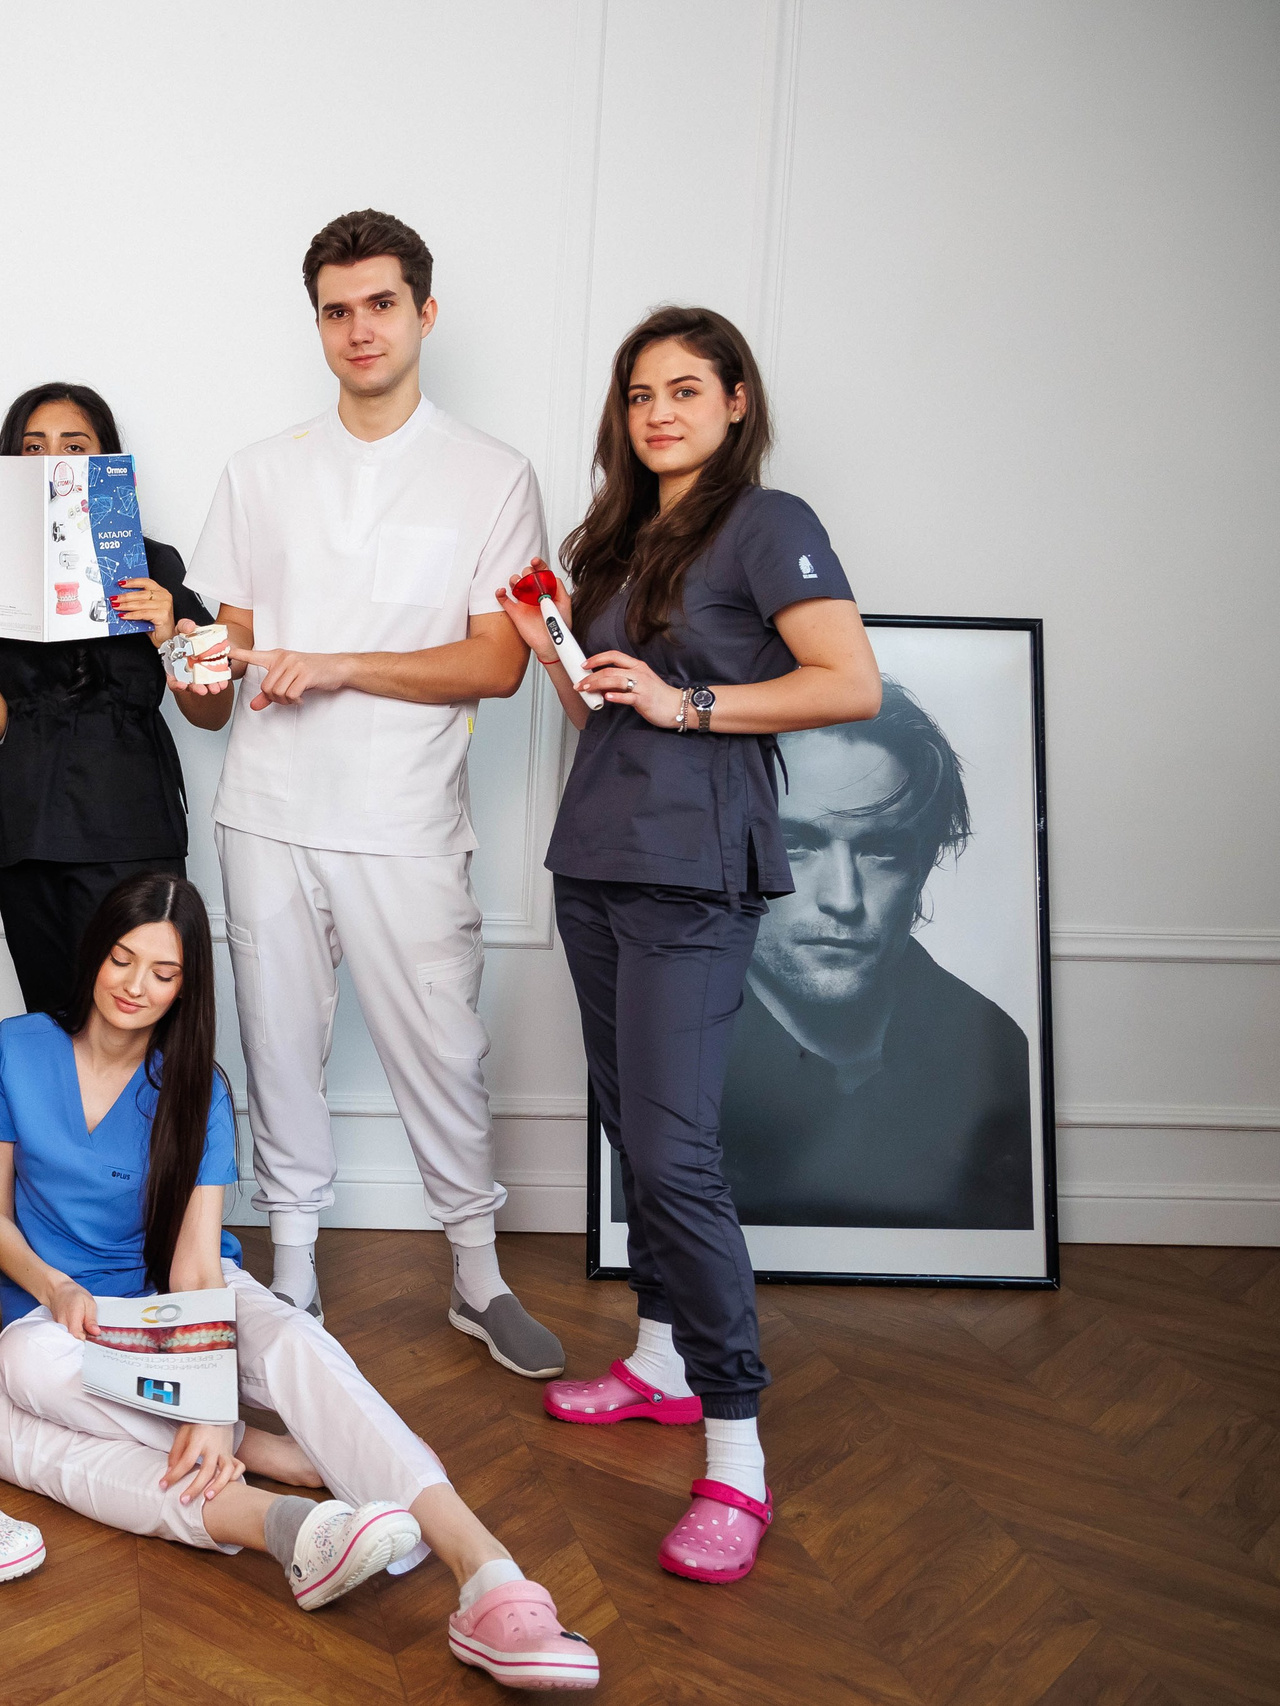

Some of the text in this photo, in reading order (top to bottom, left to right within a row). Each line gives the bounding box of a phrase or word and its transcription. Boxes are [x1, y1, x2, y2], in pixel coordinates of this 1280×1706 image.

[106, 466, 128, 474] Ormco
[98, 530, 133, 539] КАТАЛОГ
[99, 541, 121, 549] 2020
